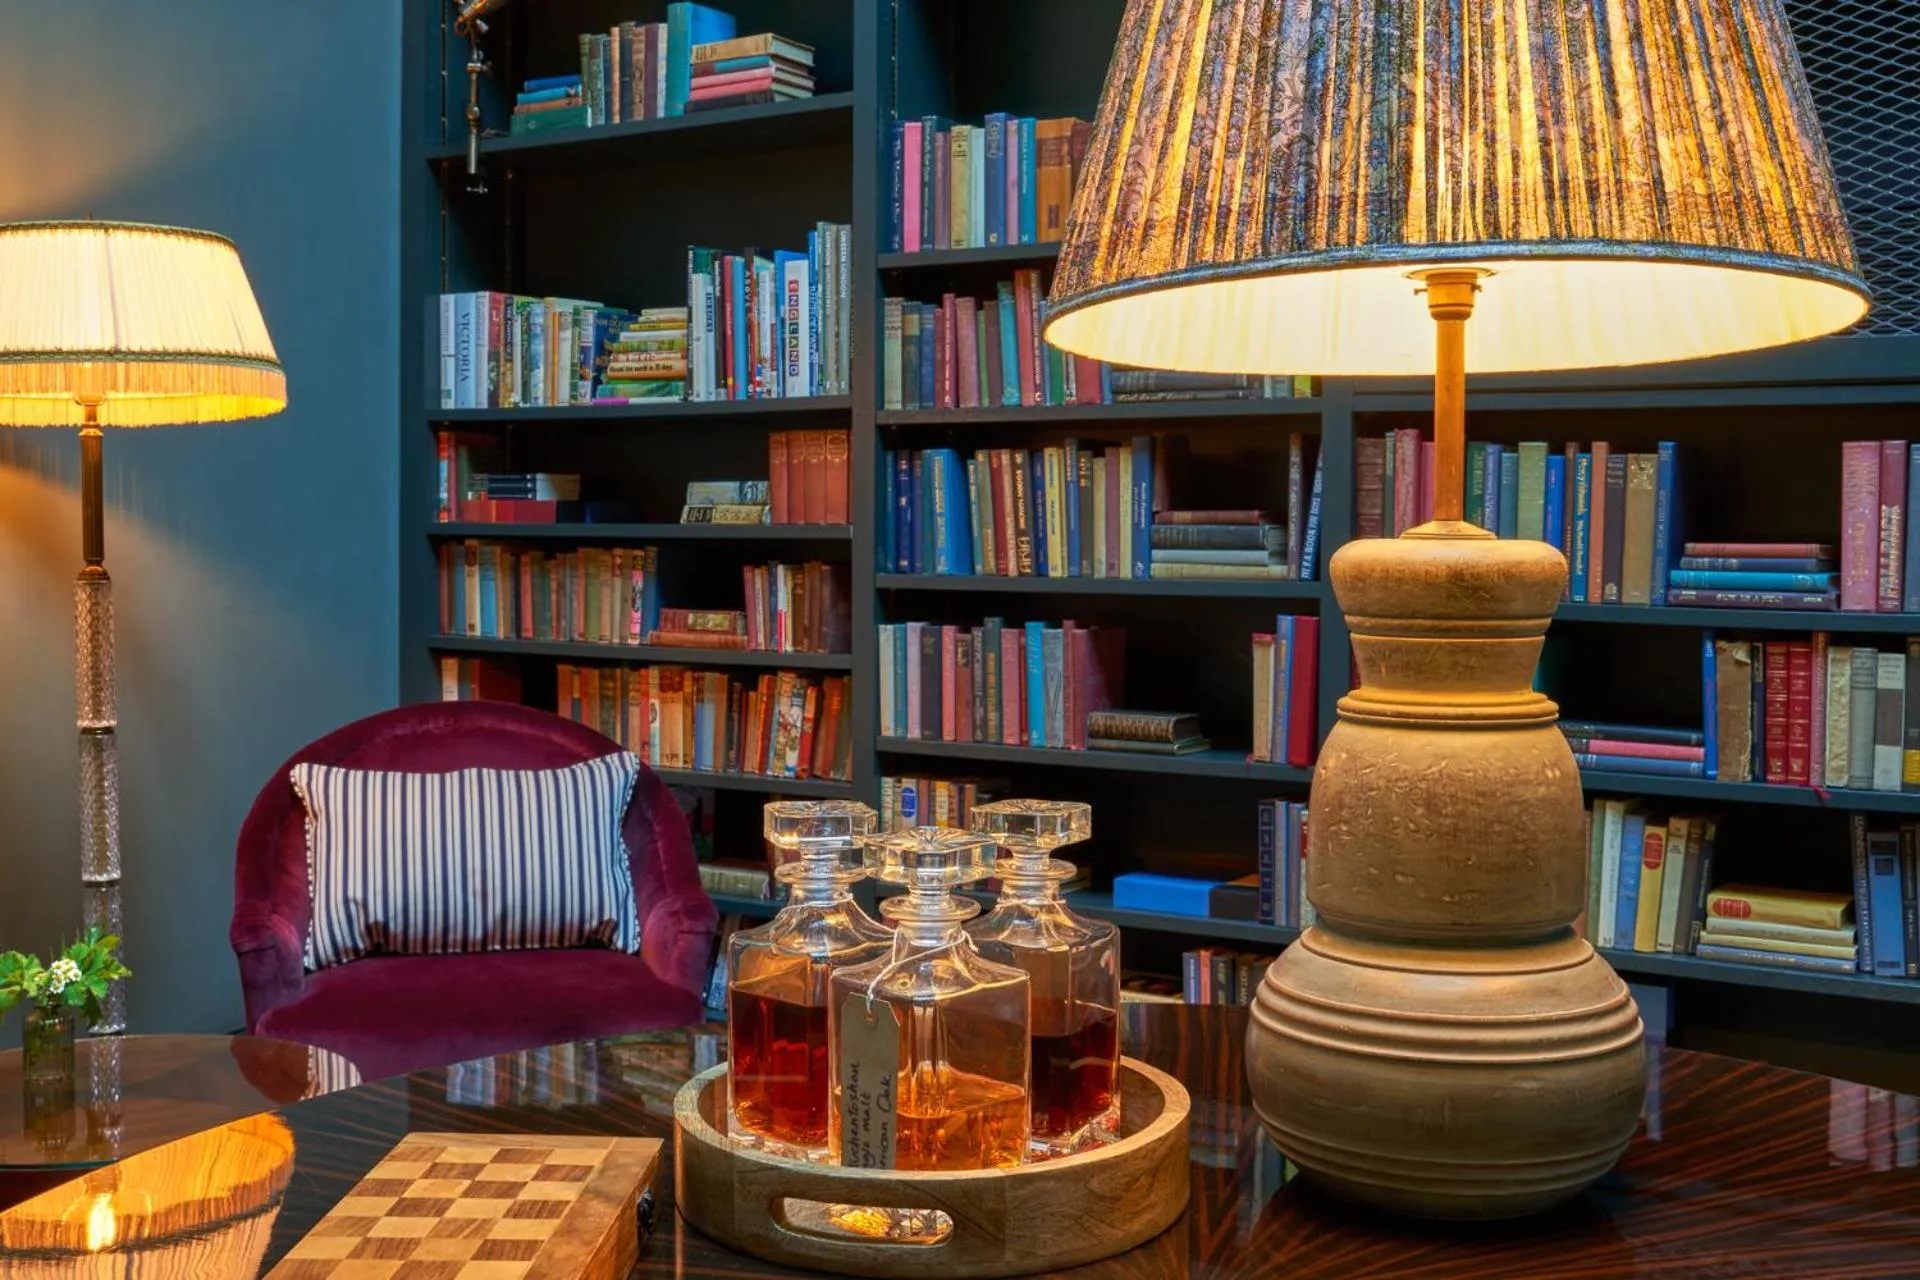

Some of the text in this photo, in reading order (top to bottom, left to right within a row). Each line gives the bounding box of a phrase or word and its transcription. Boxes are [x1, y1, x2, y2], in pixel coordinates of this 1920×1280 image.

[839, 263, 847, 298] LONDON
[460, 312, 472, 383] VICTORIA
[788, 280, 799, 377] ENGLAND
[1303, 529, 1316, 553] BOOK
[860, 1090, 871, 1131] malt
[876, 1073, 892, 1113] Oak
